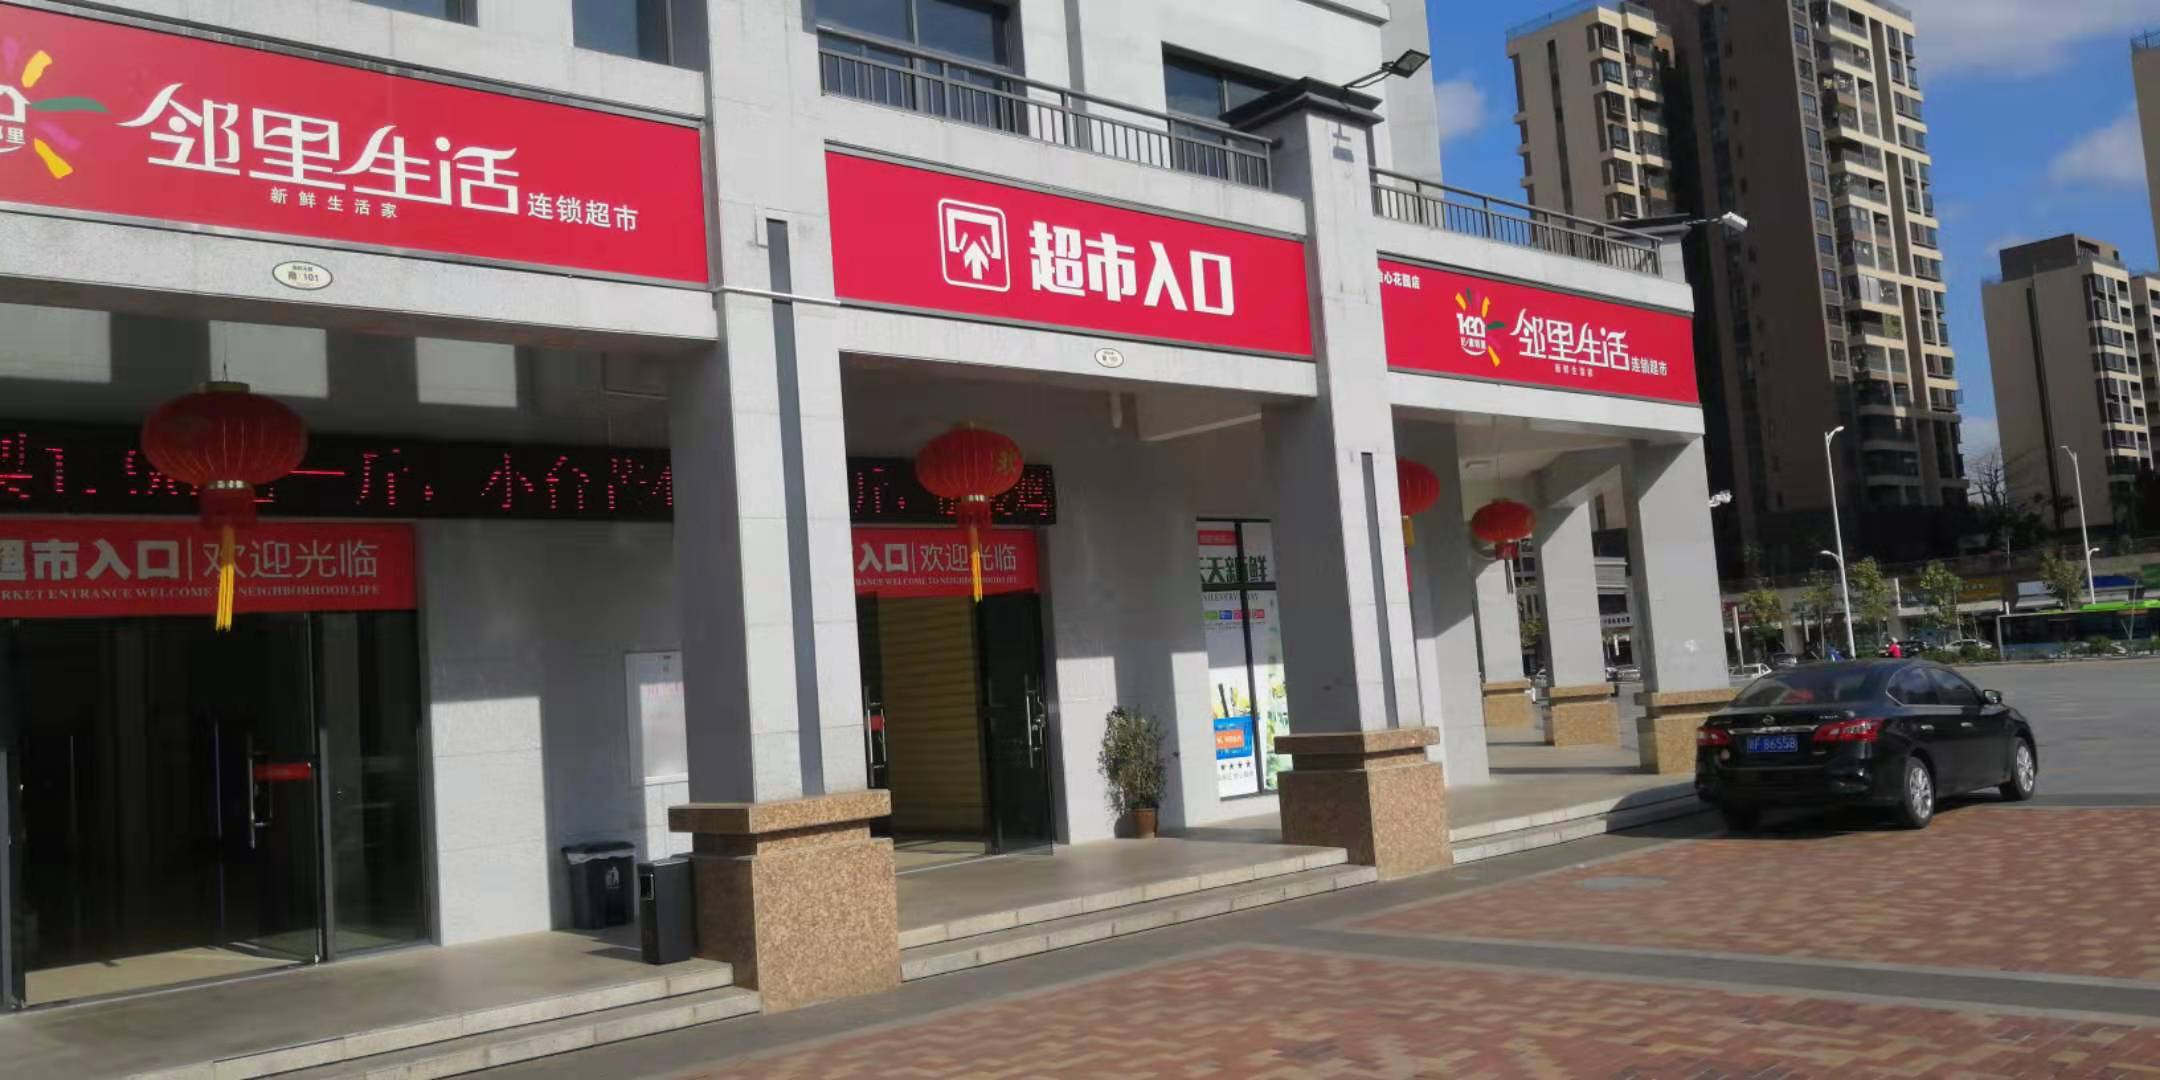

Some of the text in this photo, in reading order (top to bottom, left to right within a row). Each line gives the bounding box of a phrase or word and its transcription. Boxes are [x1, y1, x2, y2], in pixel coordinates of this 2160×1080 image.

[115, 83, 519, 216] 邻里生活
[270, 186, 399, 219] 新鲜生活家
[526, 191, 639, 232] 连锁超市
[1029, 220, 1234, 316] 超市入口
[1509, 308, 1630, 371] 邻里生活
[1631, 356, 1668, 377] 连锁超市
[203, 539, 378, 578] 欢迎光临
[920, 543, 1017, 573] 欢迎光临
[48, 588, 130, 600] ENTRANCE
[136, 586, 211, 598] WELCOME
[239, 585, 348, 597] NEIGHBORHOOD
[351, 584, 379, 596] LIFE
